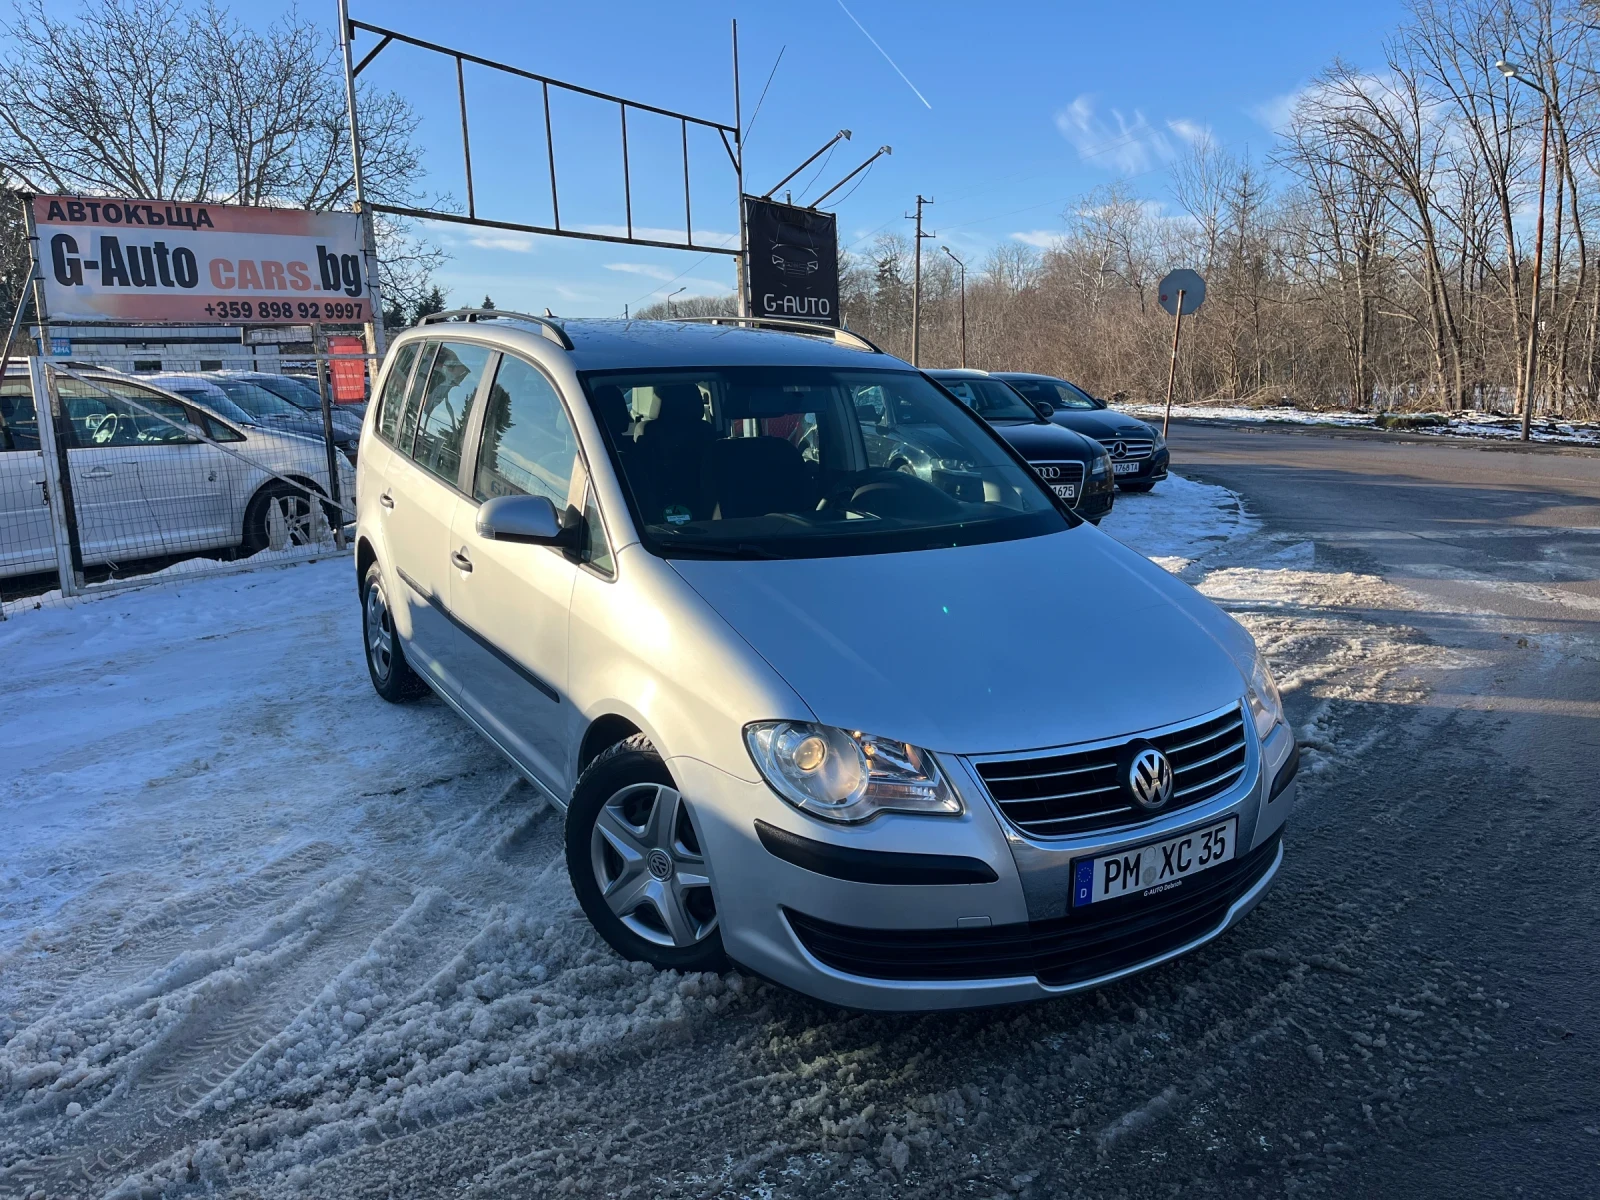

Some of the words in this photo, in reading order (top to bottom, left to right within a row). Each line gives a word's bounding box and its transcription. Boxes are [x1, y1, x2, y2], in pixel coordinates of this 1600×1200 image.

[47, 200, 214, 231] АВТОКЪЩА
[51, 233, 199, 289] G-Auto
[205, 302, 253, 319] +359
[258, 302, 294, 319] 898
[298, 303, 321, 319] 92
[324, 303, 363, 319] 9997
[763, 293, 830, 315] G-AUTO
[1104, 852, 1142, 895] PM
[1159, 838, 1193, 880] XC
[1198, 825, 1227, 866] 35
[1079, 888, 1088, 899] D
